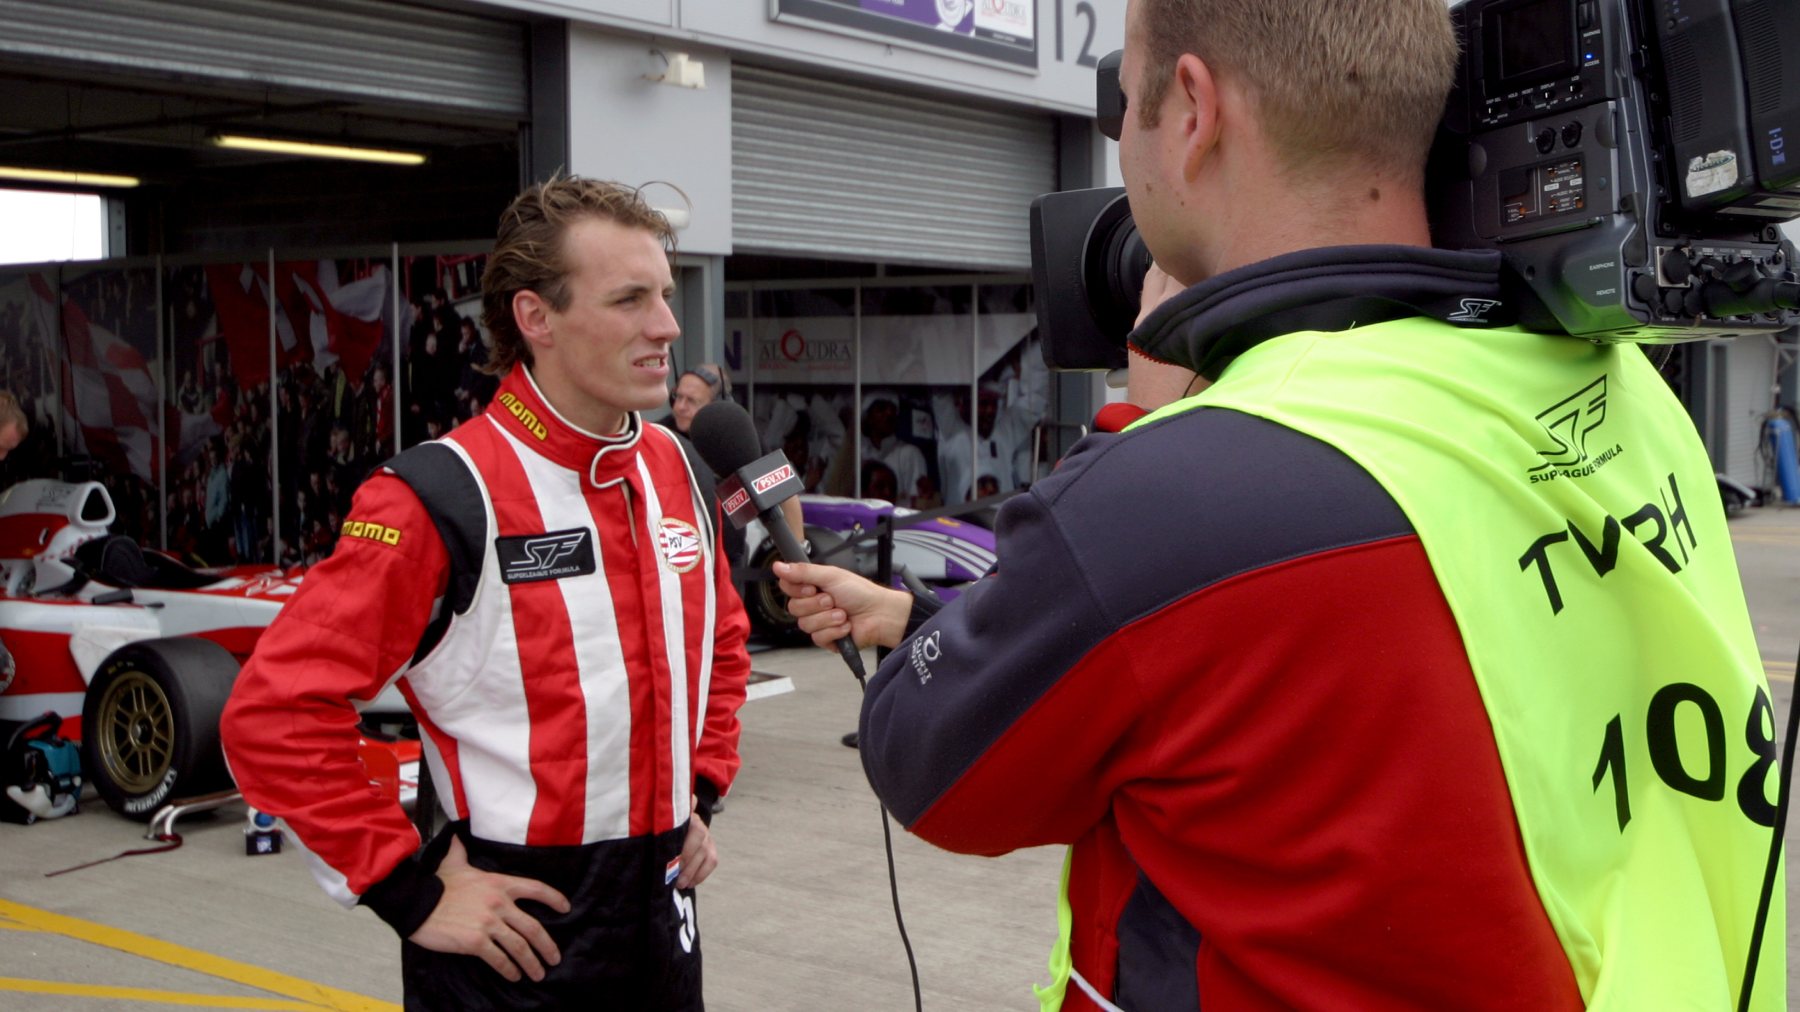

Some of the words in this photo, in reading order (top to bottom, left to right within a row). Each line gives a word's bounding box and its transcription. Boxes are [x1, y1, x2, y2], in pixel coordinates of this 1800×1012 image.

[1054, 0, 1098, 68] 12
[760, 470, 787, 488] PSV.TV
[668, 535, 683, 549] PSV
[1591, 682, 1780, 835] 108
